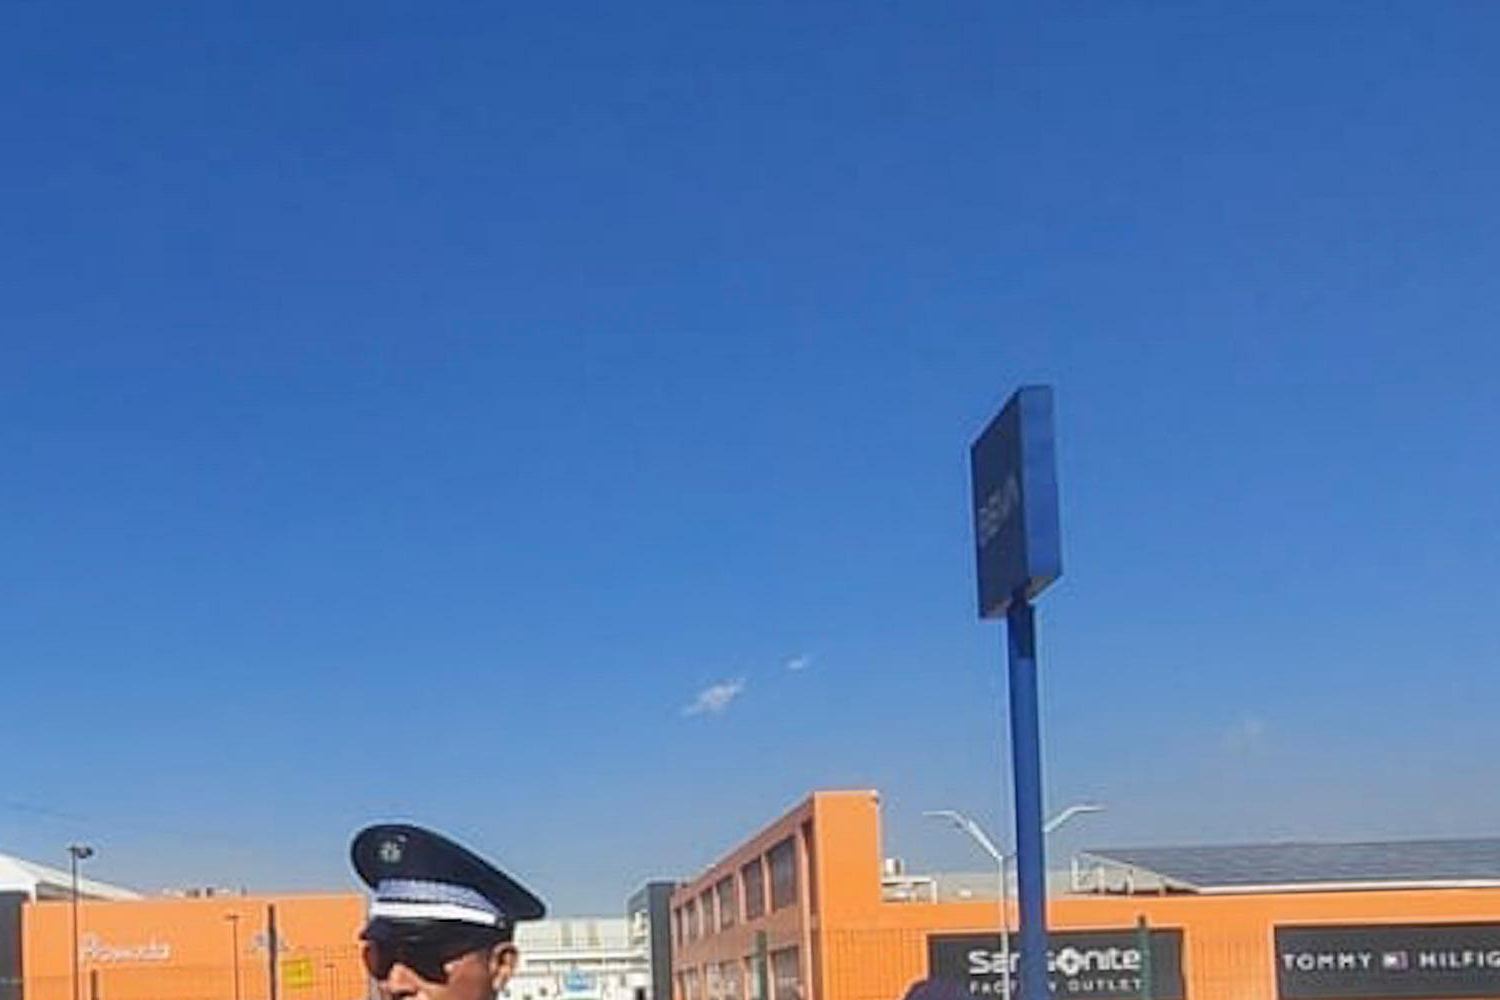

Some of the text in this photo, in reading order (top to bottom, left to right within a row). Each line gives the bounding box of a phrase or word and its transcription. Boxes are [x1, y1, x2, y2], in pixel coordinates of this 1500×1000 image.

[967, 947, 1142, 976] Saonite
[1282, 952, 1374, 971] TOMMY
[1068, 978, 1143, 993] OUTLET
